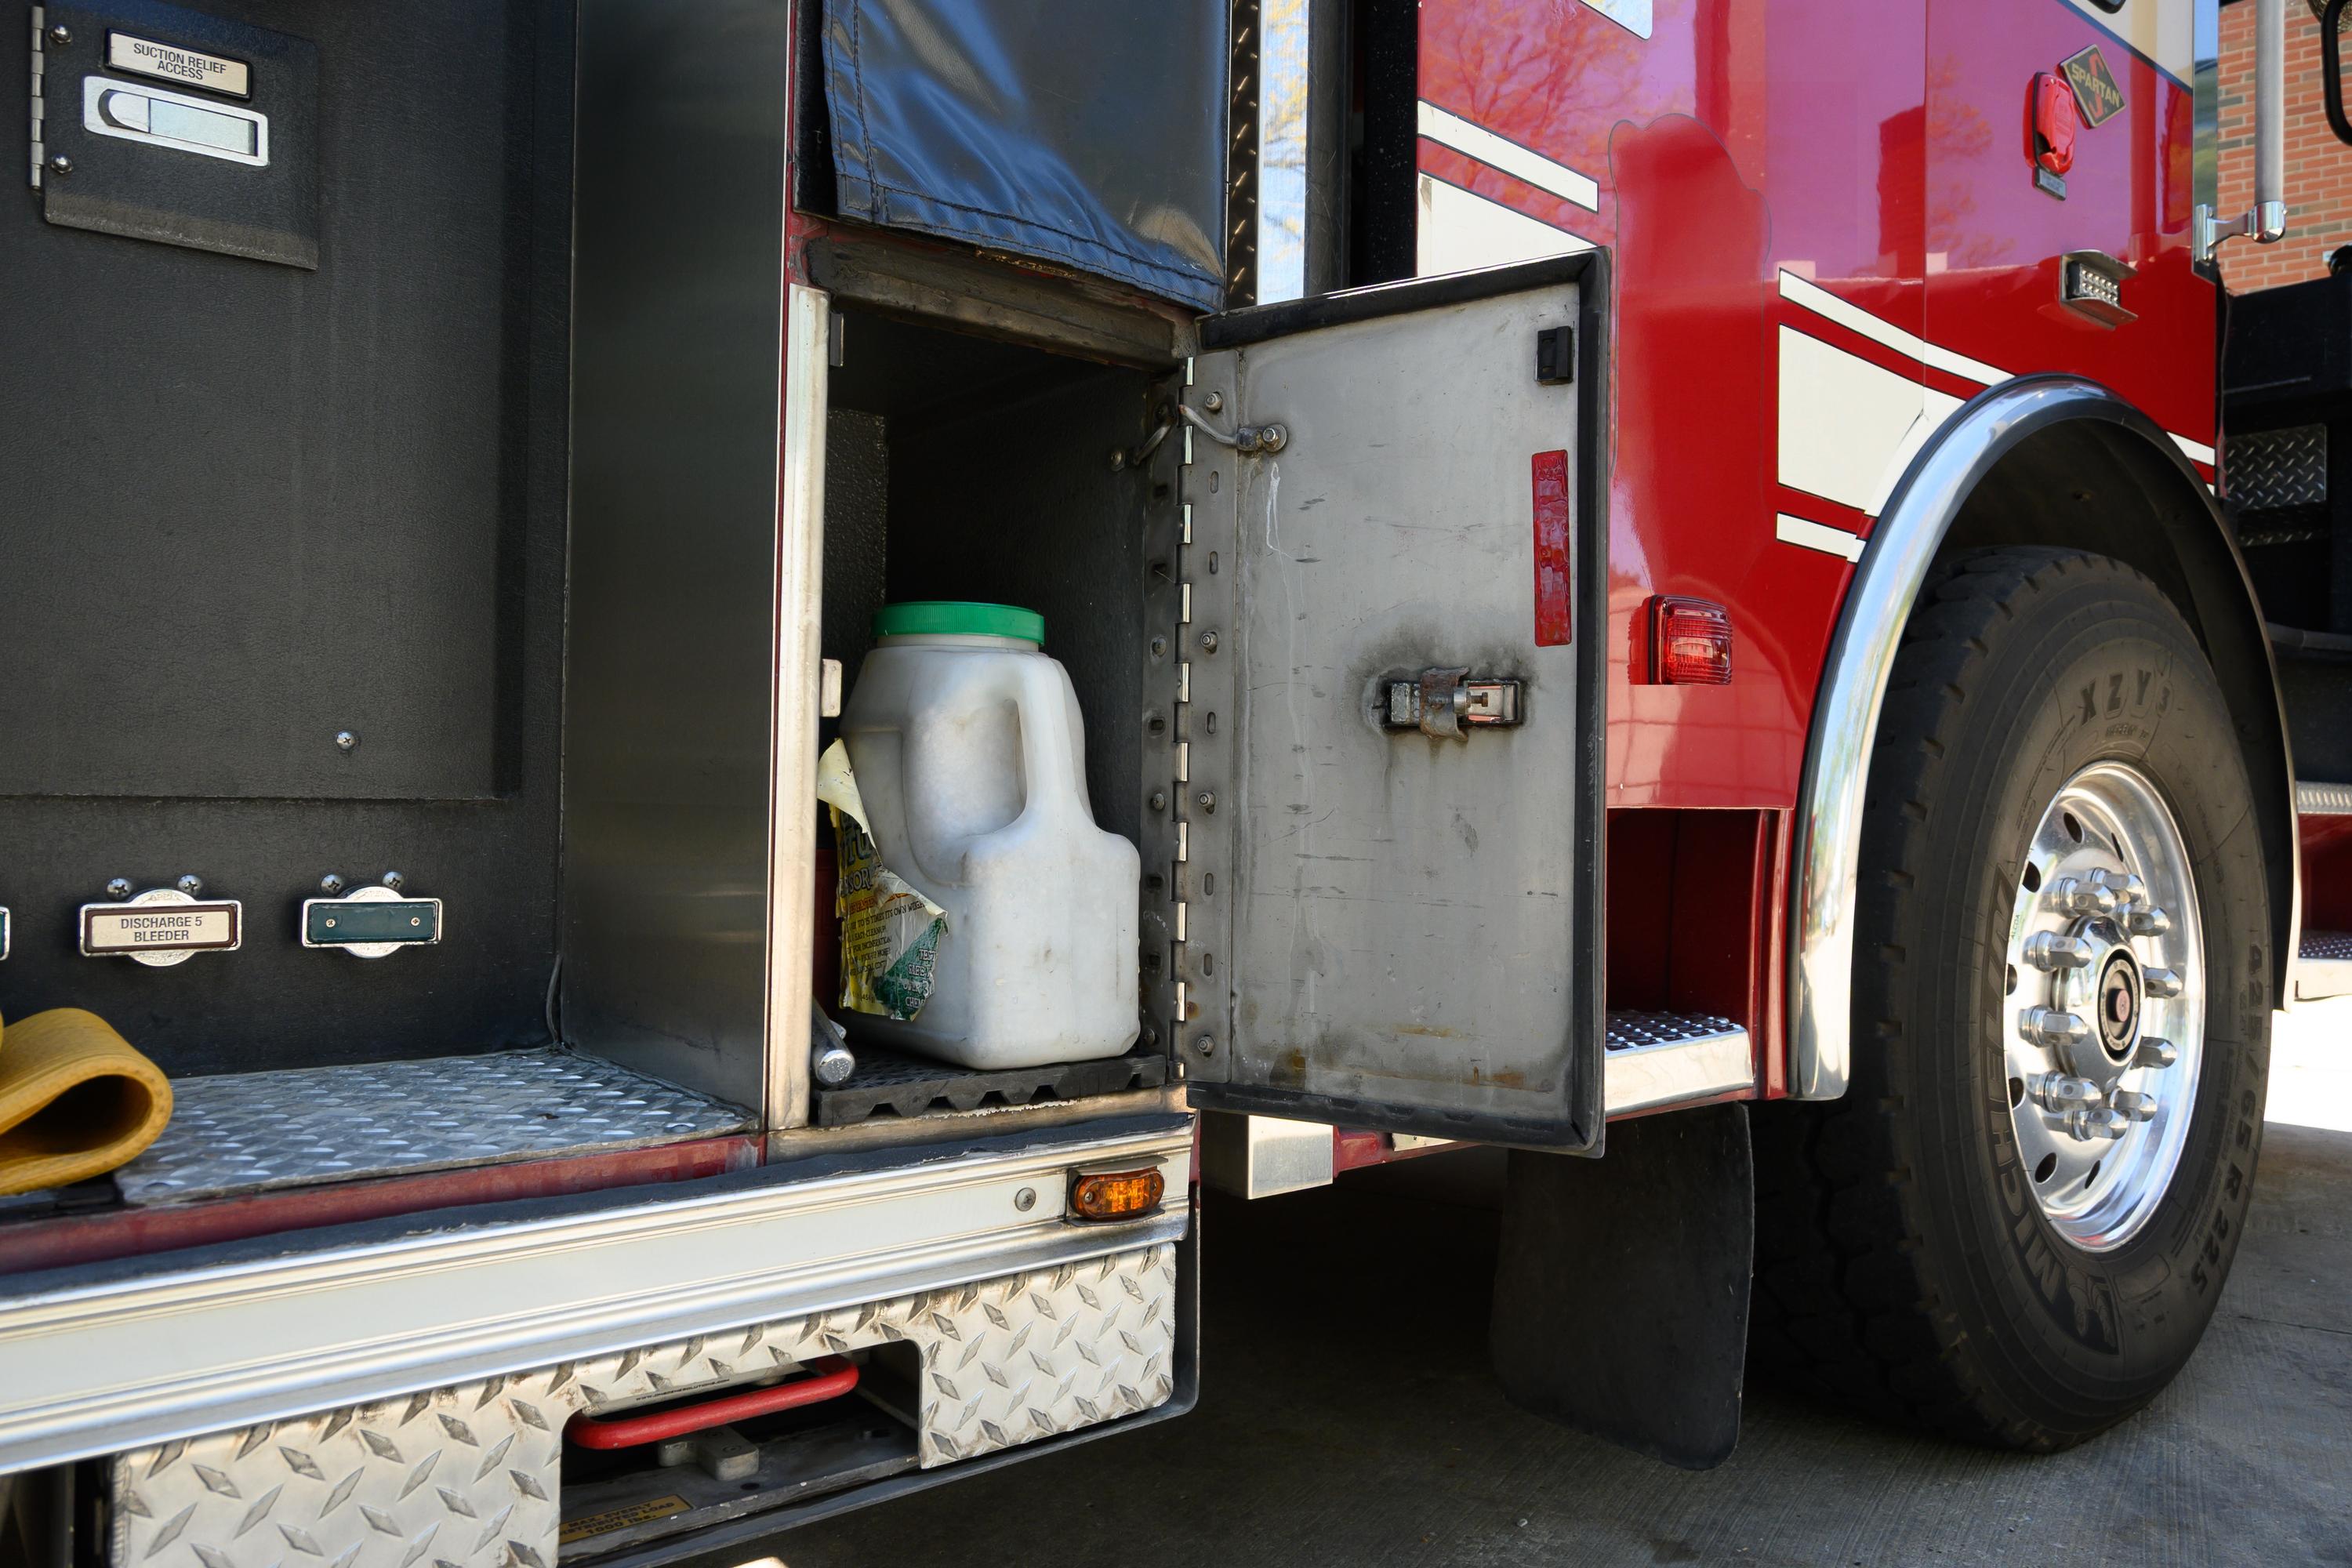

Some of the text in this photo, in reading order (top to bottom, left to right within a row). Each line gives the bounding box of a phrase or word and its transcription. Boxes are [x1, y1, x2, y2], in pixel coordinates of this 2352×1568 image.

[133, 43, 227, 74] SUCTION RELIEF
[157, 60, 203, 80] ACCESS
[2071, 63, 2120, 107] SPARTAN
[894, 906, 906, 916] OWN
[121, 916, 202, 929] DISCHARGE 5
[134, 930, 189, 942] BLEEDER
[1987, 882, 2063, 1303] MICHELIN
[560, 1502, 675, 1534] ISTRIBUTED LOAD
[568, 1503, 652, 1528] MAX. EVENLY
[586, 1514, 657, 1534] 1000 lbs.
